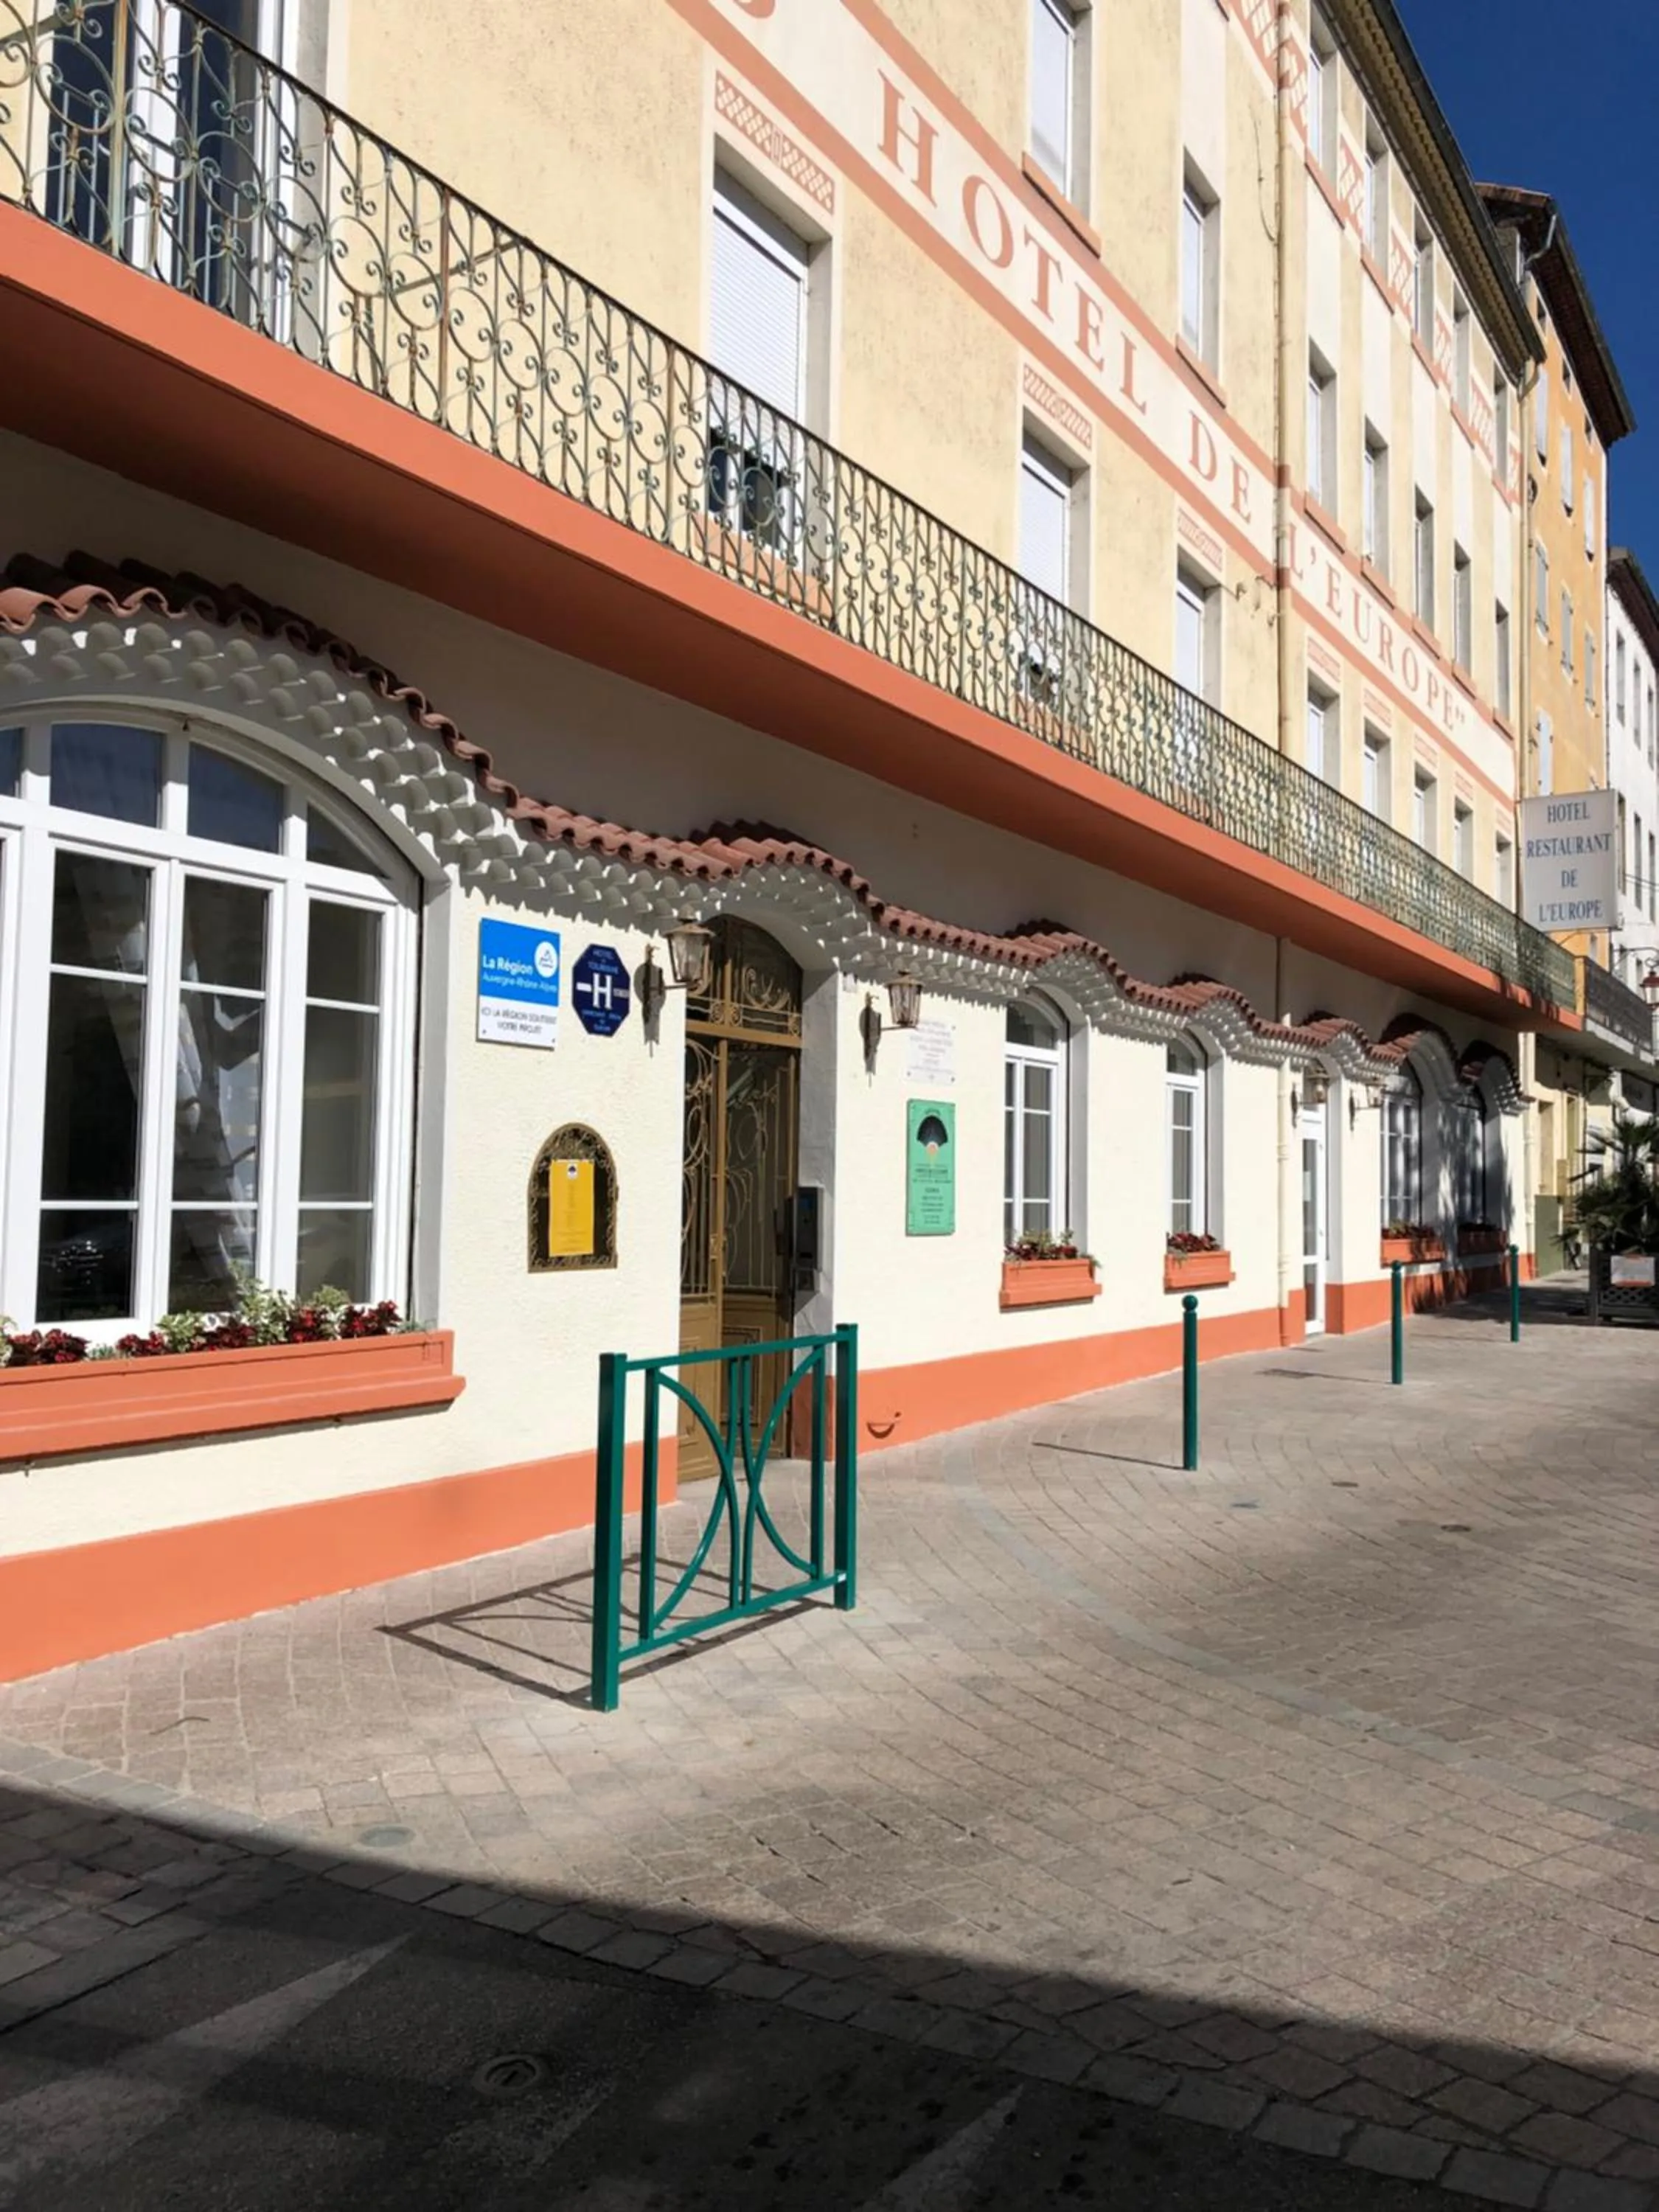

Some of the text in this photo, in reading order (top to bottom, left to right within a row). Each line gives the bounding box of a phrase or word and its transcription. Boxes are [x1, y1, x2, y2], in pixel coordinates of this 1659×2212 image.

[877, 68, 1147, 415] HOTEL
[1189, 411, 1252, 524] DE
[1547, 800, 1590, 824] HOTEL
[1526, 832, 1611, 858] RESTAURANT
[1561, 869, 1578, 888] DE
[1539, 900, 1604, 922] L'EUROPE
[482, 954, 495, 970] La
[593, 973, 612, 1009] H
